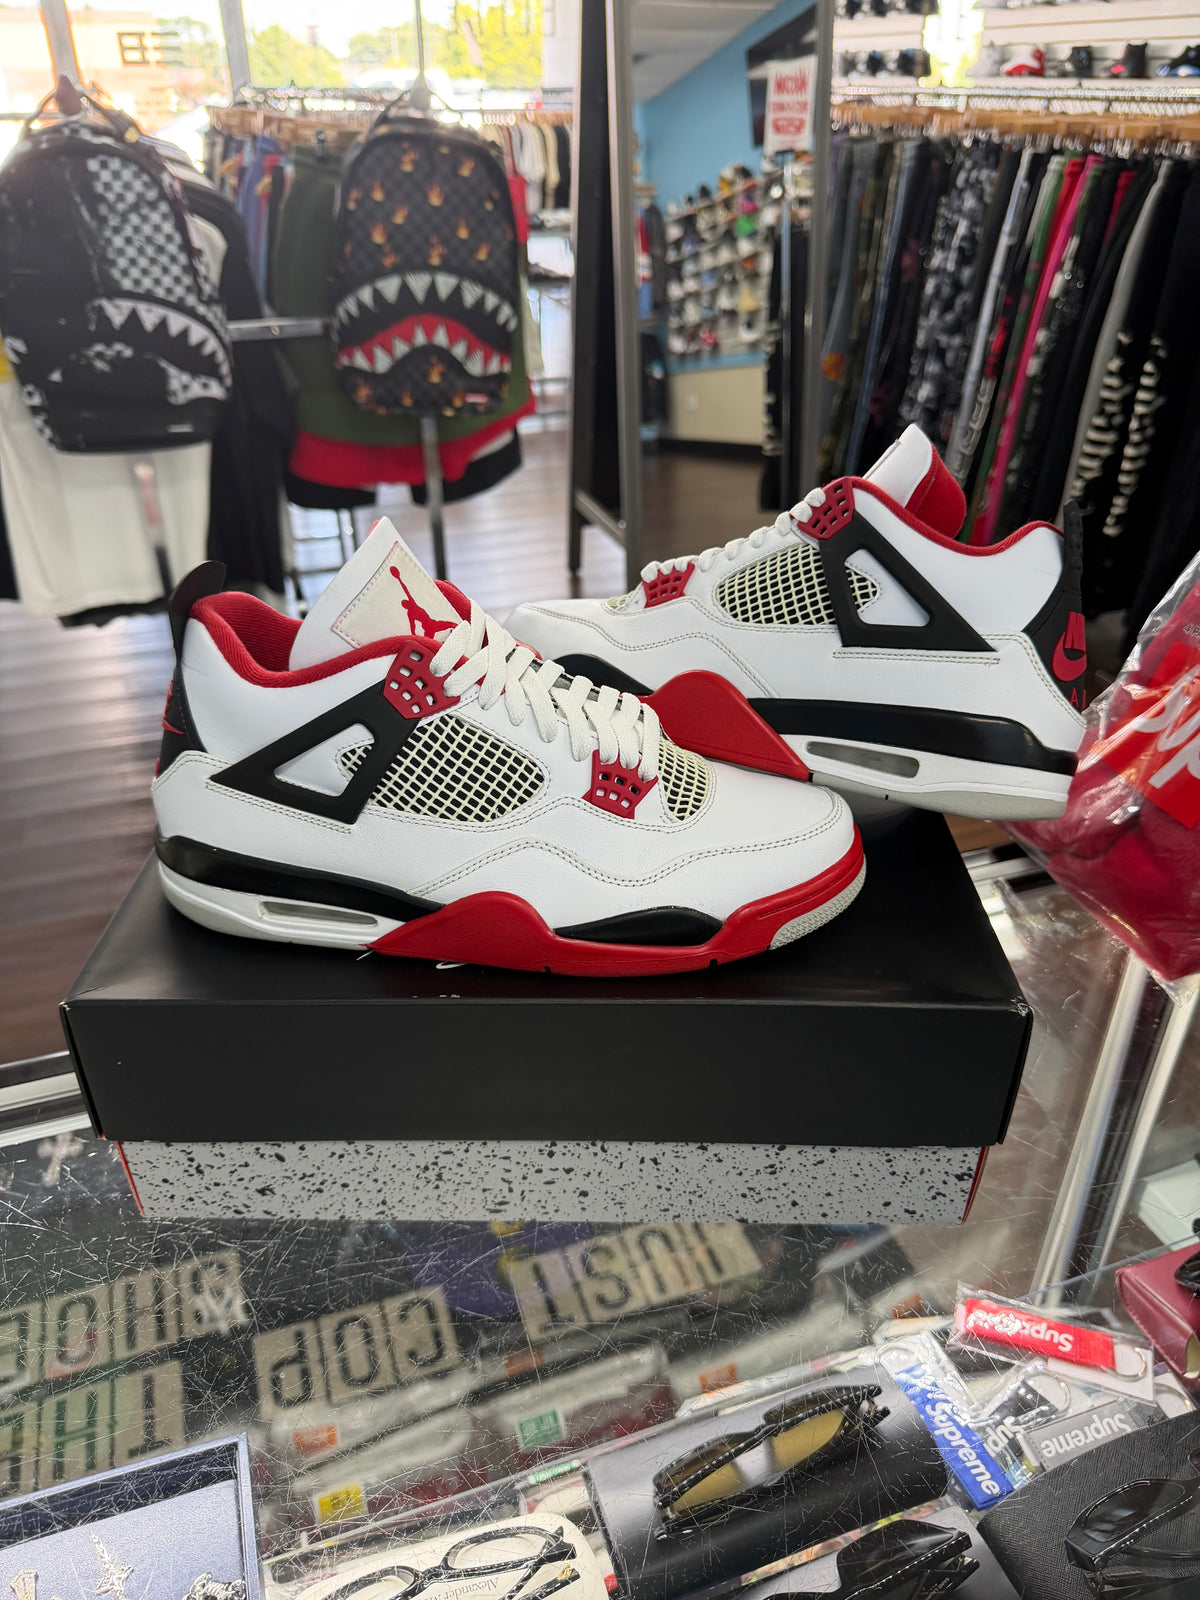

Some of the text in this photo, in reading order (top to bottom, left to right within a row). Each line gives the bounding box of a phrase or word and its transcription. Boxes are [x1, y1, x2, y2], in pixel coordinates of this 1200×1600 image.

[268, 1296, 445, 1410] COP
[925, 1403, 1001, 1497] Supreme
[1040, 1412, 1132, 1458] Supreme
[443, 1577, 499, 1600] Alexander
